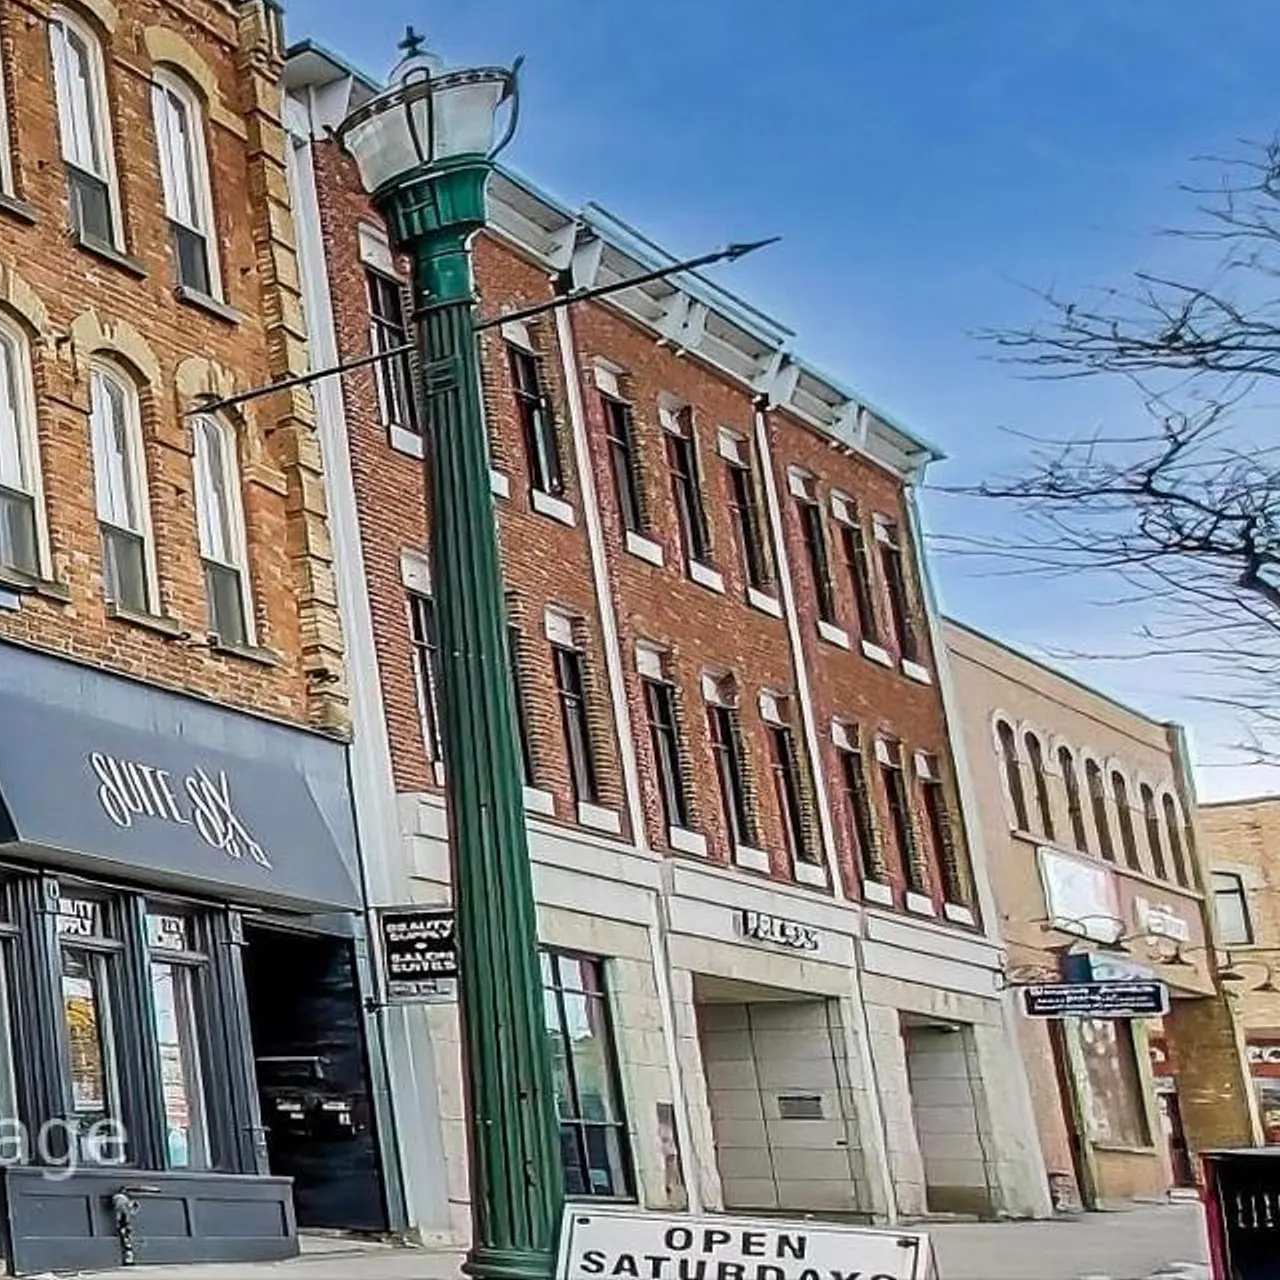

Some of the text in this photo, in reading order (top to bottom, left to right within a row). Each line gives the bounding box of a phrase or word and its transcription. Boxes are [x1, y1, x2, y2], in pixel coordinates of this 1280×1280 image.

[91, 751, 193, 828] SUITE
[386, 919, 454, 933] BEAUTY
[663, 1226, 807, 1260] OPEN
[579, 1250, 900, 1280] SATURD
